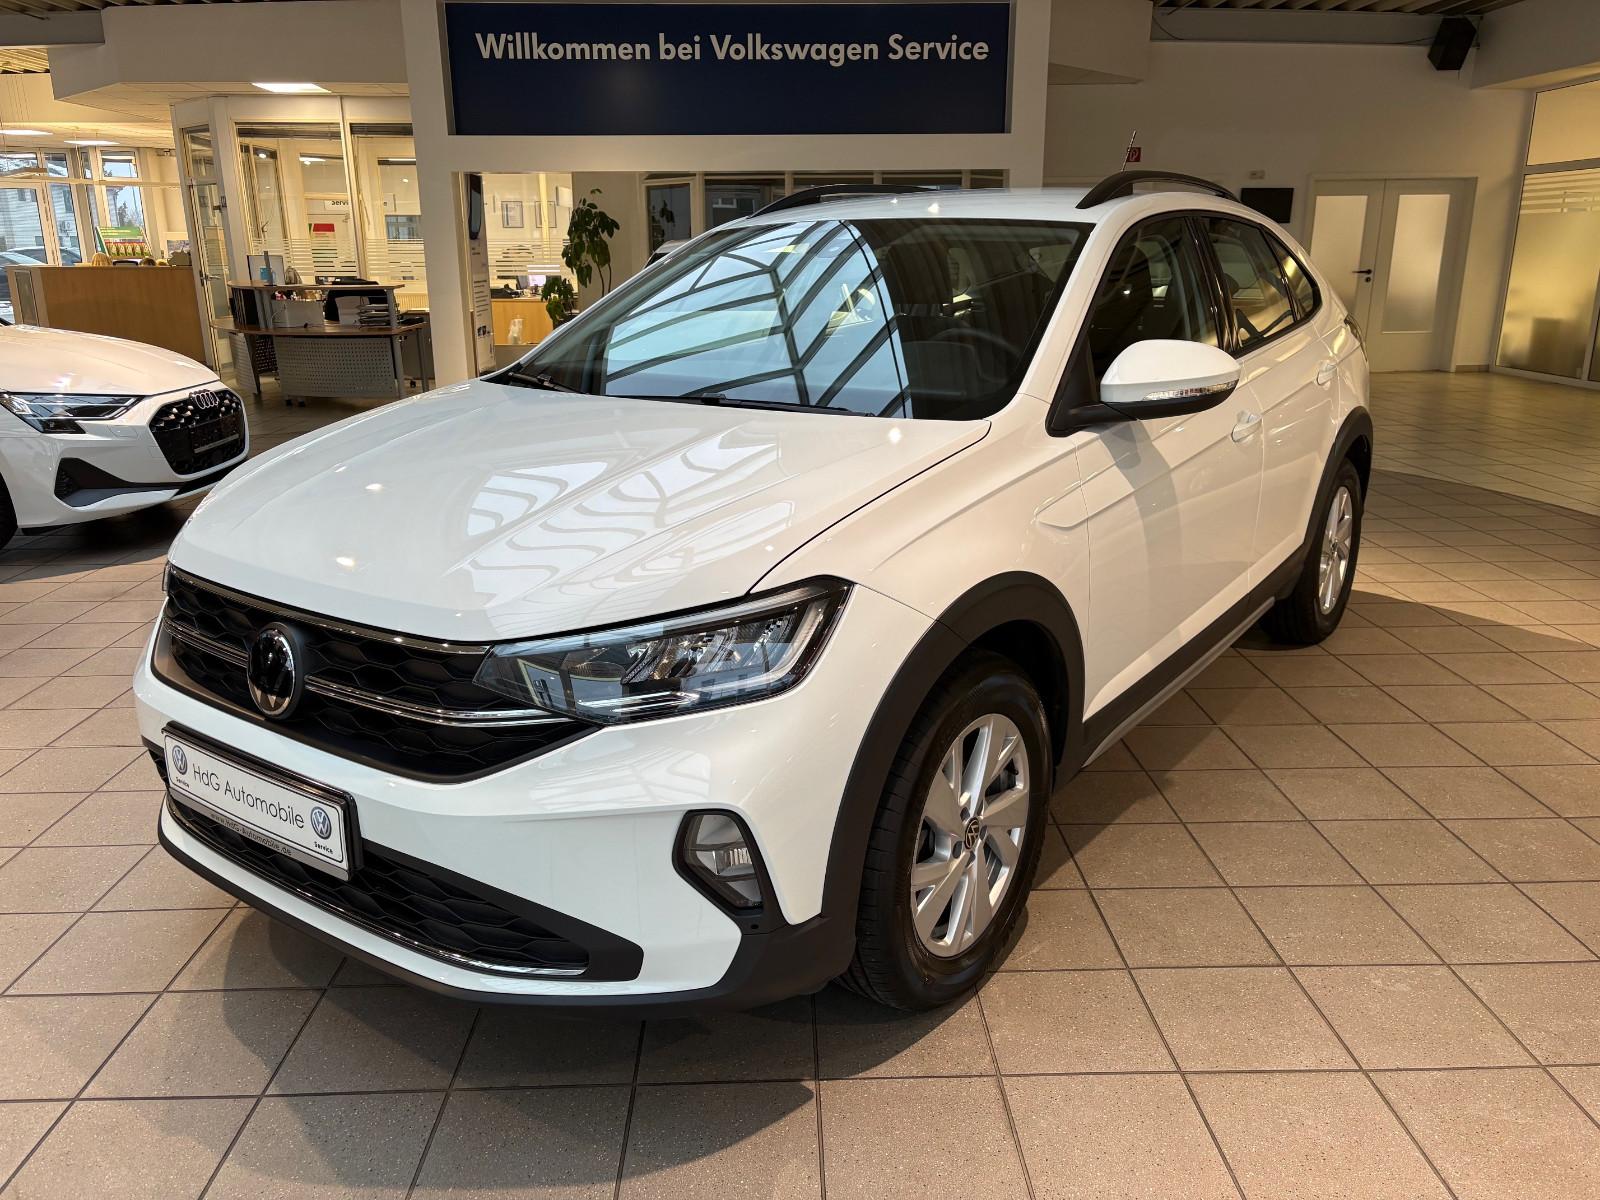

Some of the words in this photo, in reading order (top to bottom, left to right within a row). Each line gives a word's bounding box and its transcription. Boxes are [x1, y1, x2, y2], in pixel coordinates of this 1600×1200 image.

[475, 32, 651, 61] Willkommen
[658, 33, 701, 61] bei
[709, 33, 878, 67] Volkswagen
[887, 33, 989, 61] Service
[193, 763, 220, 791] HdG
[224, 780, 305, 829] Automobile
